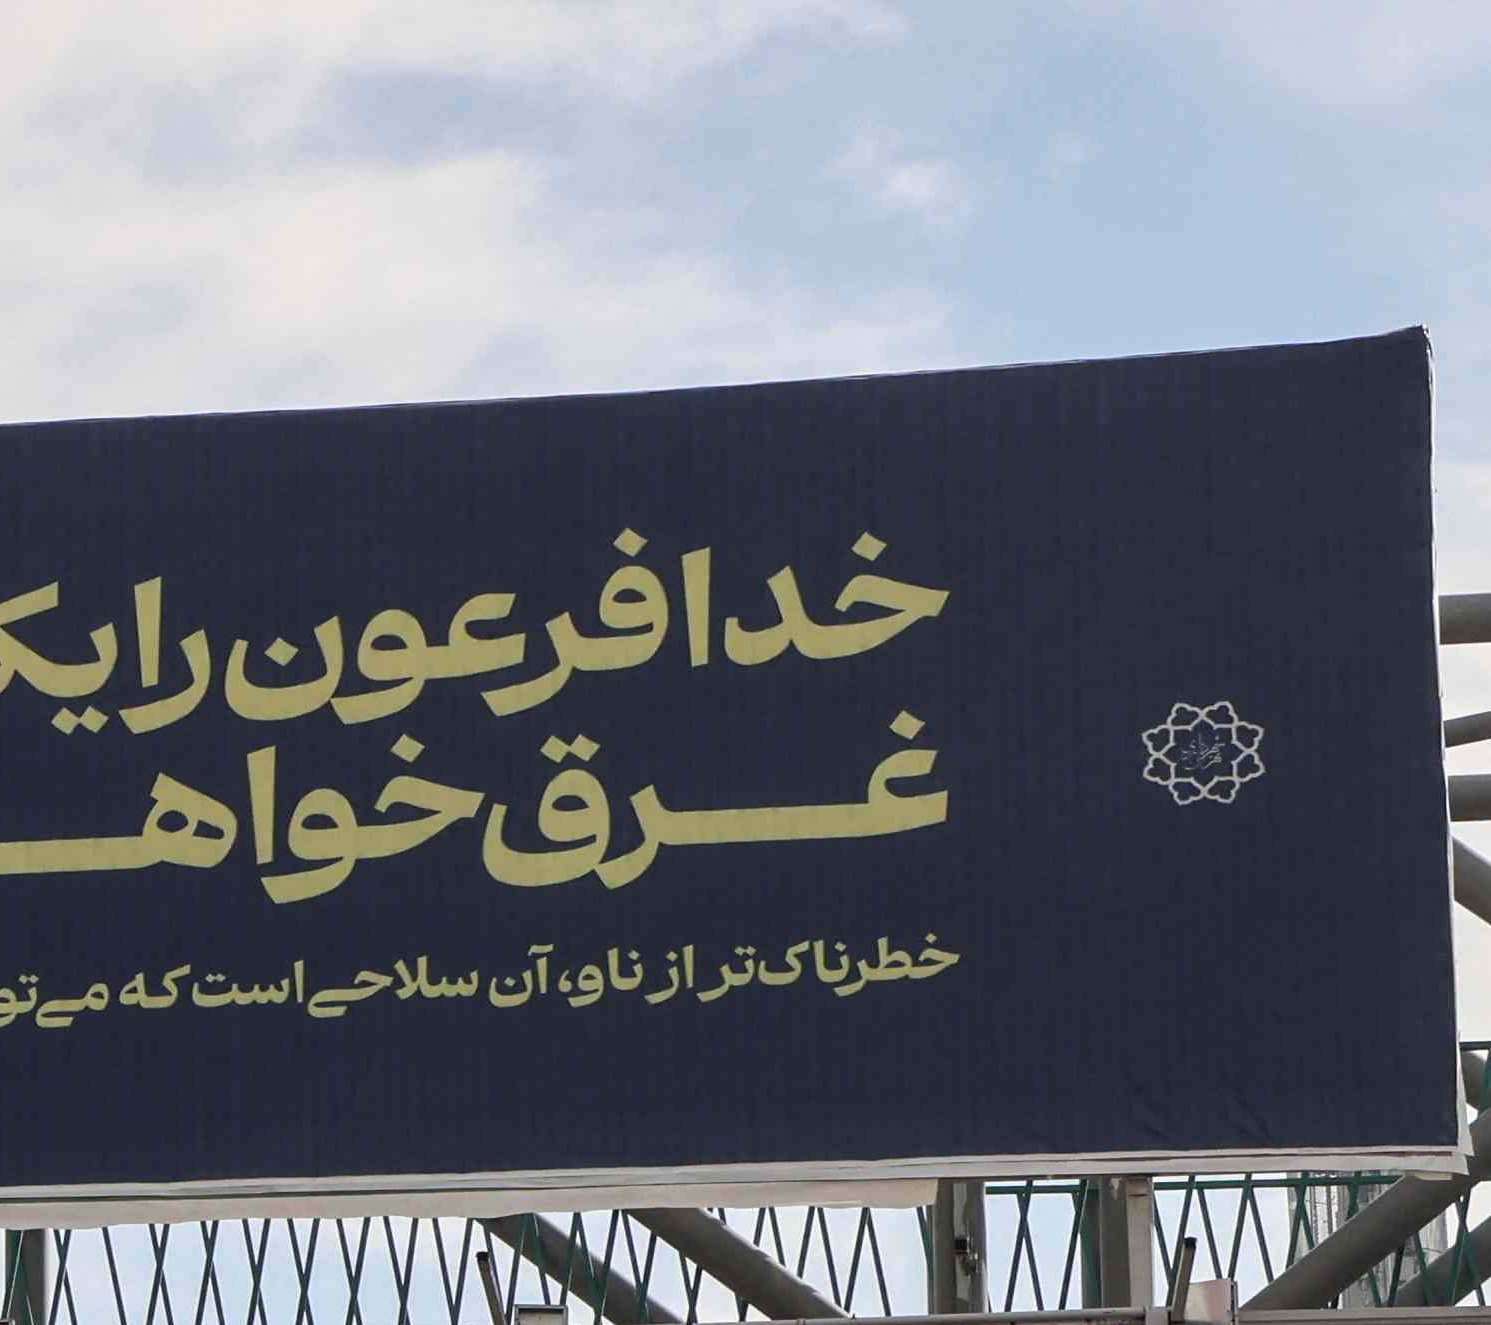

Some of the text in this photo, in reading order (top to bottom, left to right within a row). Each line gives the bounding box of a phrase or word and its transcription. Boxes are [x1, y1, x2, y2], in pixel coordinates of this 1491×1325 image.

[223, 527, 670, 723] فرعون
[680, 532, 952, 667] خدا
[120, 576, 212, 734] را
[118, 963, 192, 1009] که
[192, 959, 305, 1009] است
[307, 957, 480, 1018] سلاحی
[489, 943, 554, 1009] آن
[649, 943, 695, 1004] از
